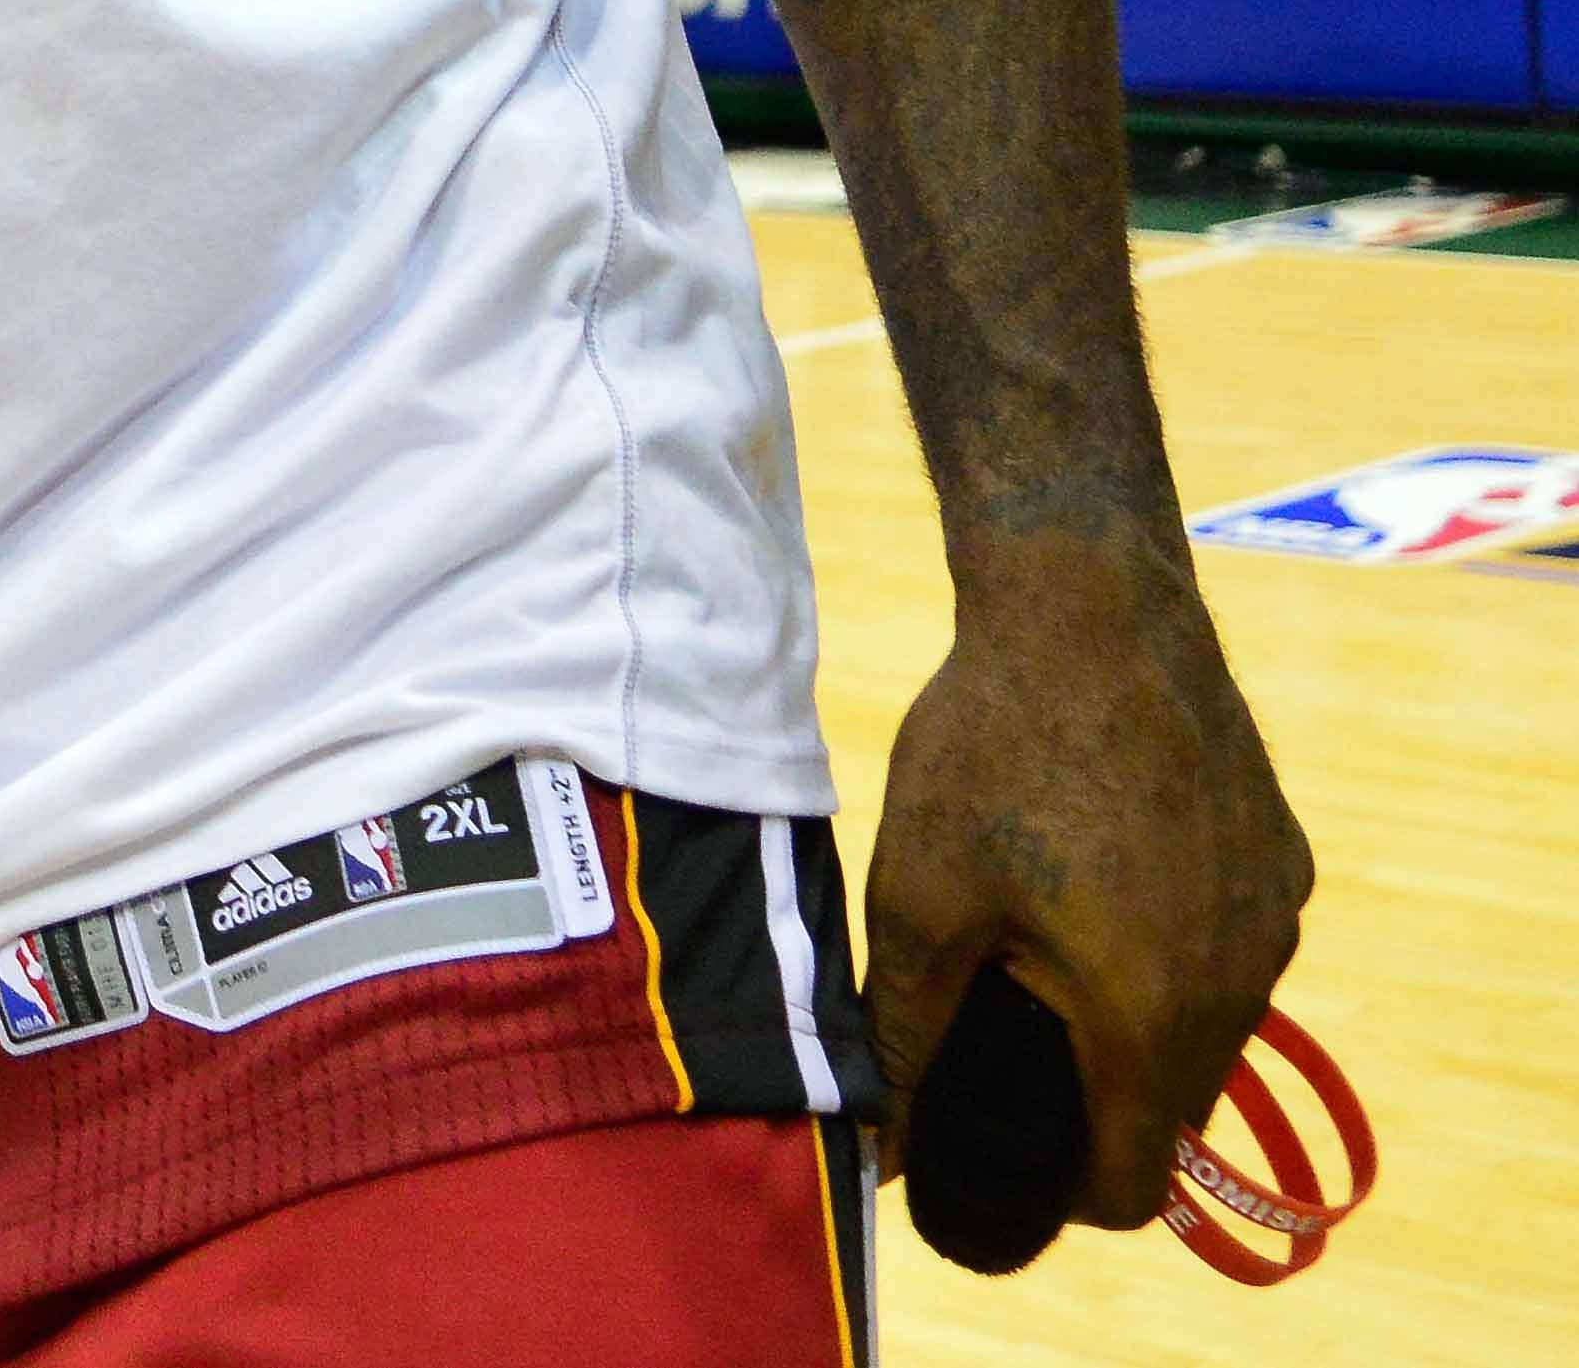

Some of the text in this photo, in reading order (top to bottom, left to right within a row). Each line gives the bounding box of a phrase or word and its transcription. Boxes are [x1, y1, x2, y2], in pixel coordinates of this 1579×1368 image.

[419, 796, 510, 843] 2XL
[562, 814, 599, 903] LENGTH
[209, 875, 314, 933] adidas
